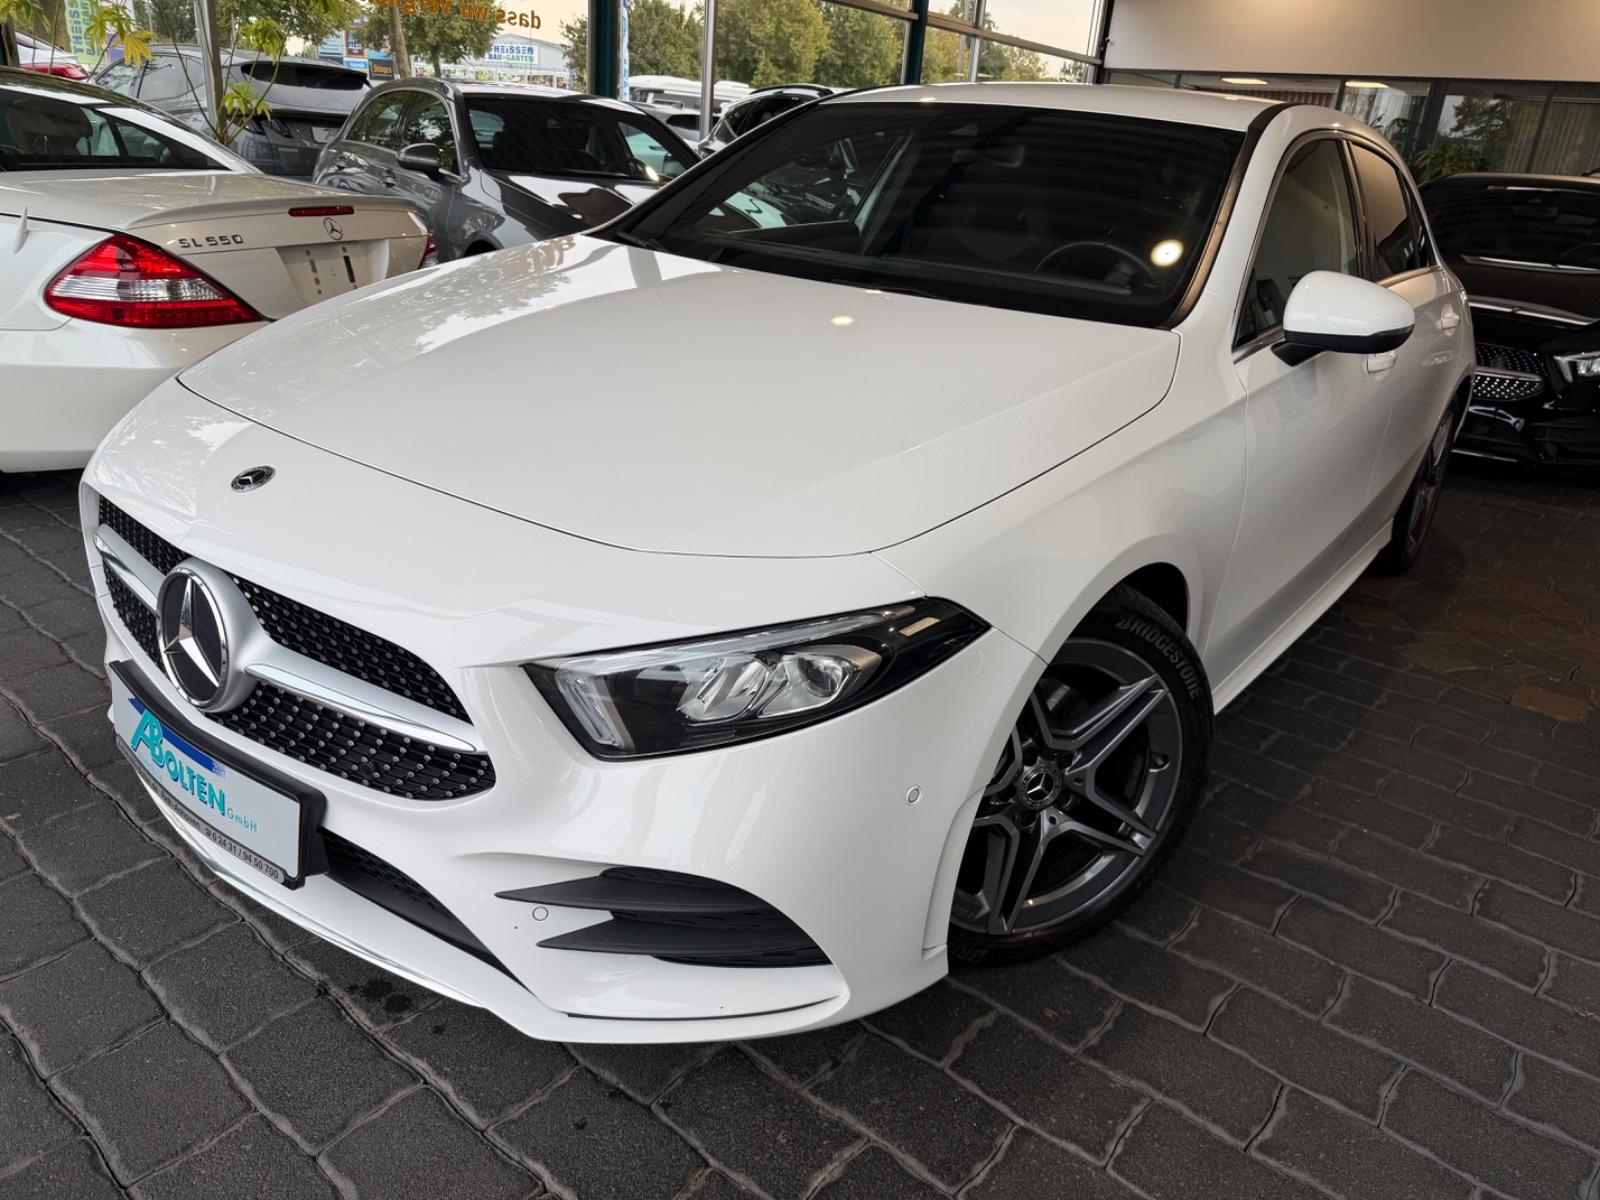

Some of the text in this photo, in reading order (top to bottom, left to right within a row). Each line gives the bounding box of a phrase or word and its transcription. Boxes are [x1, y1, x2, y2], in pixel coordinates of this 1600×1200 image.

[179, 234, 244, 249] SL 550
[226, 807, 258, 834] GmbH
